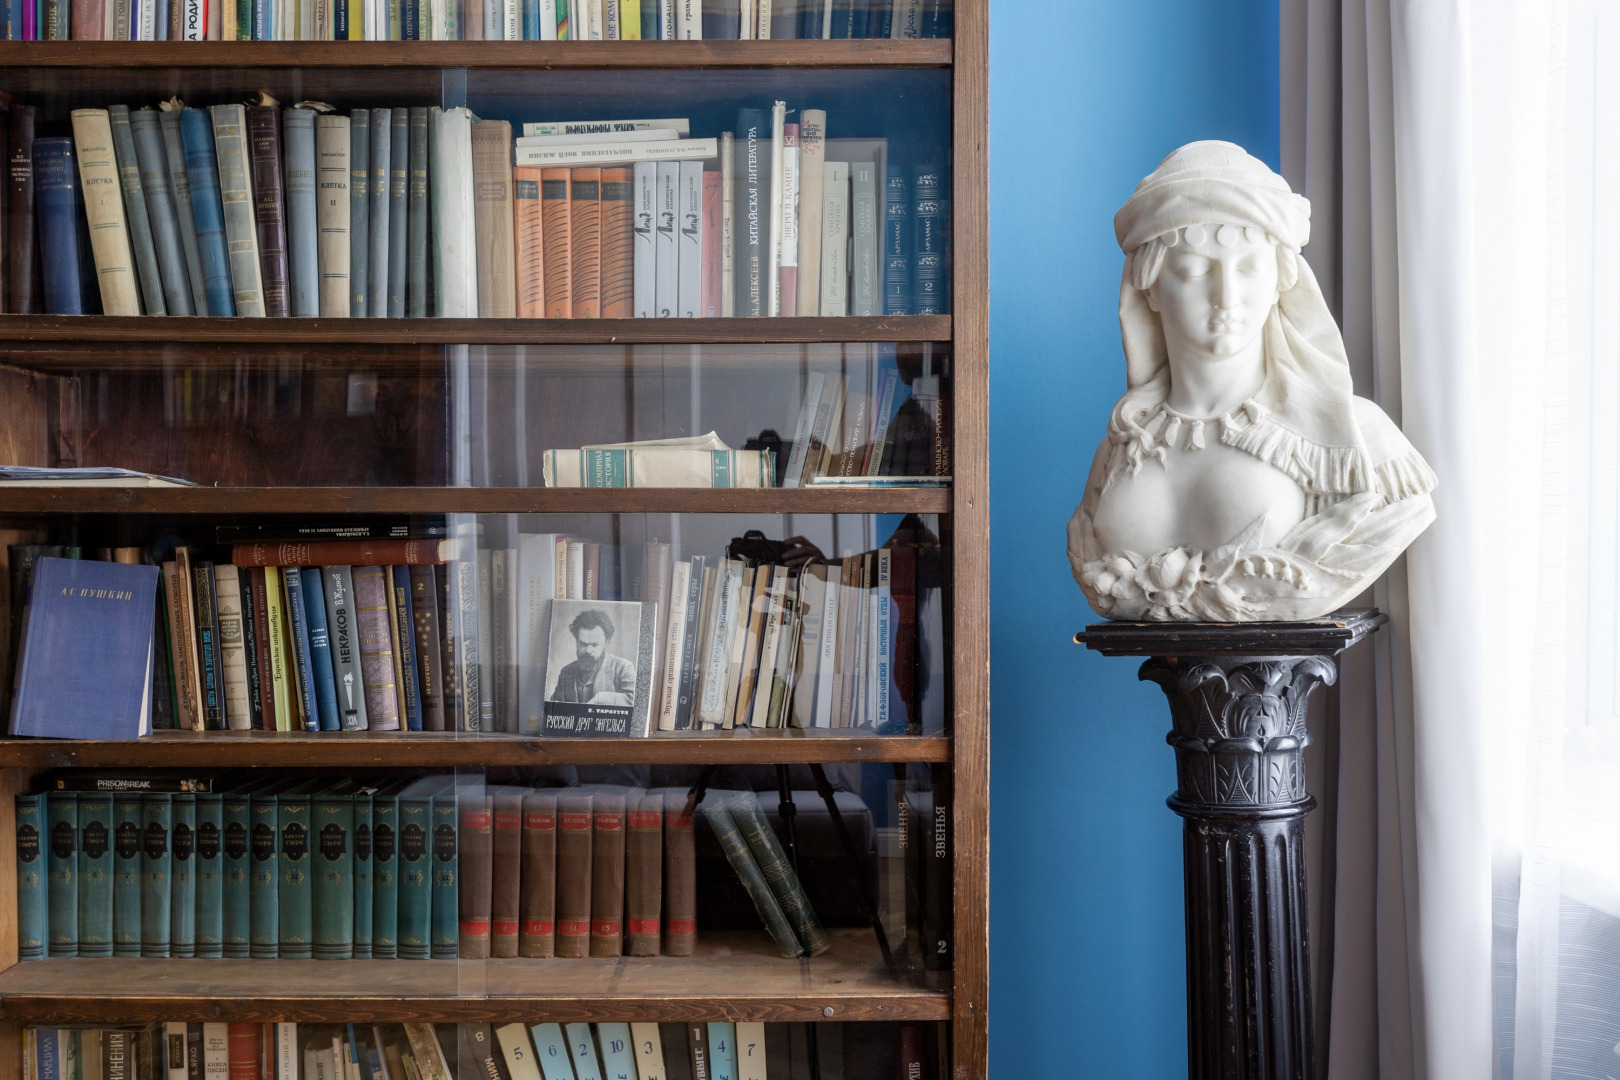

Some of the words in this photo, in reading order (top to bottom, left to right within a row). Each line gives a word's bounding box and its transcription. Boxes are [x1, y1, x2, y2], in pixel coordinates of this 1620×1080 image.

[747, 126, 758, 184] ЛИТЕРАТУРА
[86, 177, 114, 186] КЛЕТКА
[320, 181, 348, 190] КЛЕТКА
[784, 165, 794, 201] КАМНЕ
[747, 187, 759, 245] КИТАЙСКАЯ
[783, 212, 792, 242] ЗВЕРИ
[827, 200, 836, 237] СЕМЕЙНАЯ
[857, 200, 867, 237] СЕМЕЙНАЯ
[865, 203, 873, 235] ХРОНИКА
[924, 217, 932, 251] АРЗАМАС
[749, 255, 760, 305] АЛЕКСЕЕВ
[924, 281, 934, 292] 2
[880, 556, 889, 574] ВЕКА
[80, 588, 133, 601] ПУШКИН
[417, 582, 425, 591] 2
[690, 577, 699, 597] серы
[291, 592, 301, 622] КУЛЬТУРЫ
[687, 600, 696, 623] запах
[880, 596, 889, 616] ОТЦЫ
[270, 605, 281, 646] инкунабулы
[670, 622, 678, 641] стиха
[826, 597, 836, 643] PHILOLOGIAE
[295, 622, 305, 664] ПЕРВОБЫТНОЙ
[335, 608, 352, 664] НЕКРАСОВ
[398, 607, 412, 664] СТИХОВЕДЕНИЯ
[880, 619, 889, 656] ВОСТОЧНЫЕ
[666, 642, 677, 684] организация
[825, 644, 833, 658] ARS
[272, 646, 282, 682] Еврейские
[404, 665, 416, 707] ПРОБЛЕМЫ
[303, 692, 311, 716] ОЧЕРКИ
[595, 708, 629, 716] ТАРАТУТА
[663, 686, 673, 716] Звуковая
[545, 715, 575, 730] РУССКИЙ
[574, 716, 594, 733] ДРУГ
[594, 718, 627, 733] ЭНГЕЛЬСА
[899, 801, 909, 849] ЗВЕНЬЯ
[935, 805, 946, 858] ЗВЕНЬЯ
[937, 940, 947, 954] 2
[475, 1031, 485, 1042] 8
[609, 1039, 625, 1054] 10
[644, 1041, 654, 1055] 3
[717, 1040, 727, 1053] 4
[42, 1036, 55, 1080] МАРЦИАЛ
[190, 1046, 198, 1067] ЯРХО
[513, 1046, 524, 1060] 5
[548, 1044, 558, 1057] 6
[578, 1043, 589, 1057] 2
[747, 1043, 757, 1057] 7
